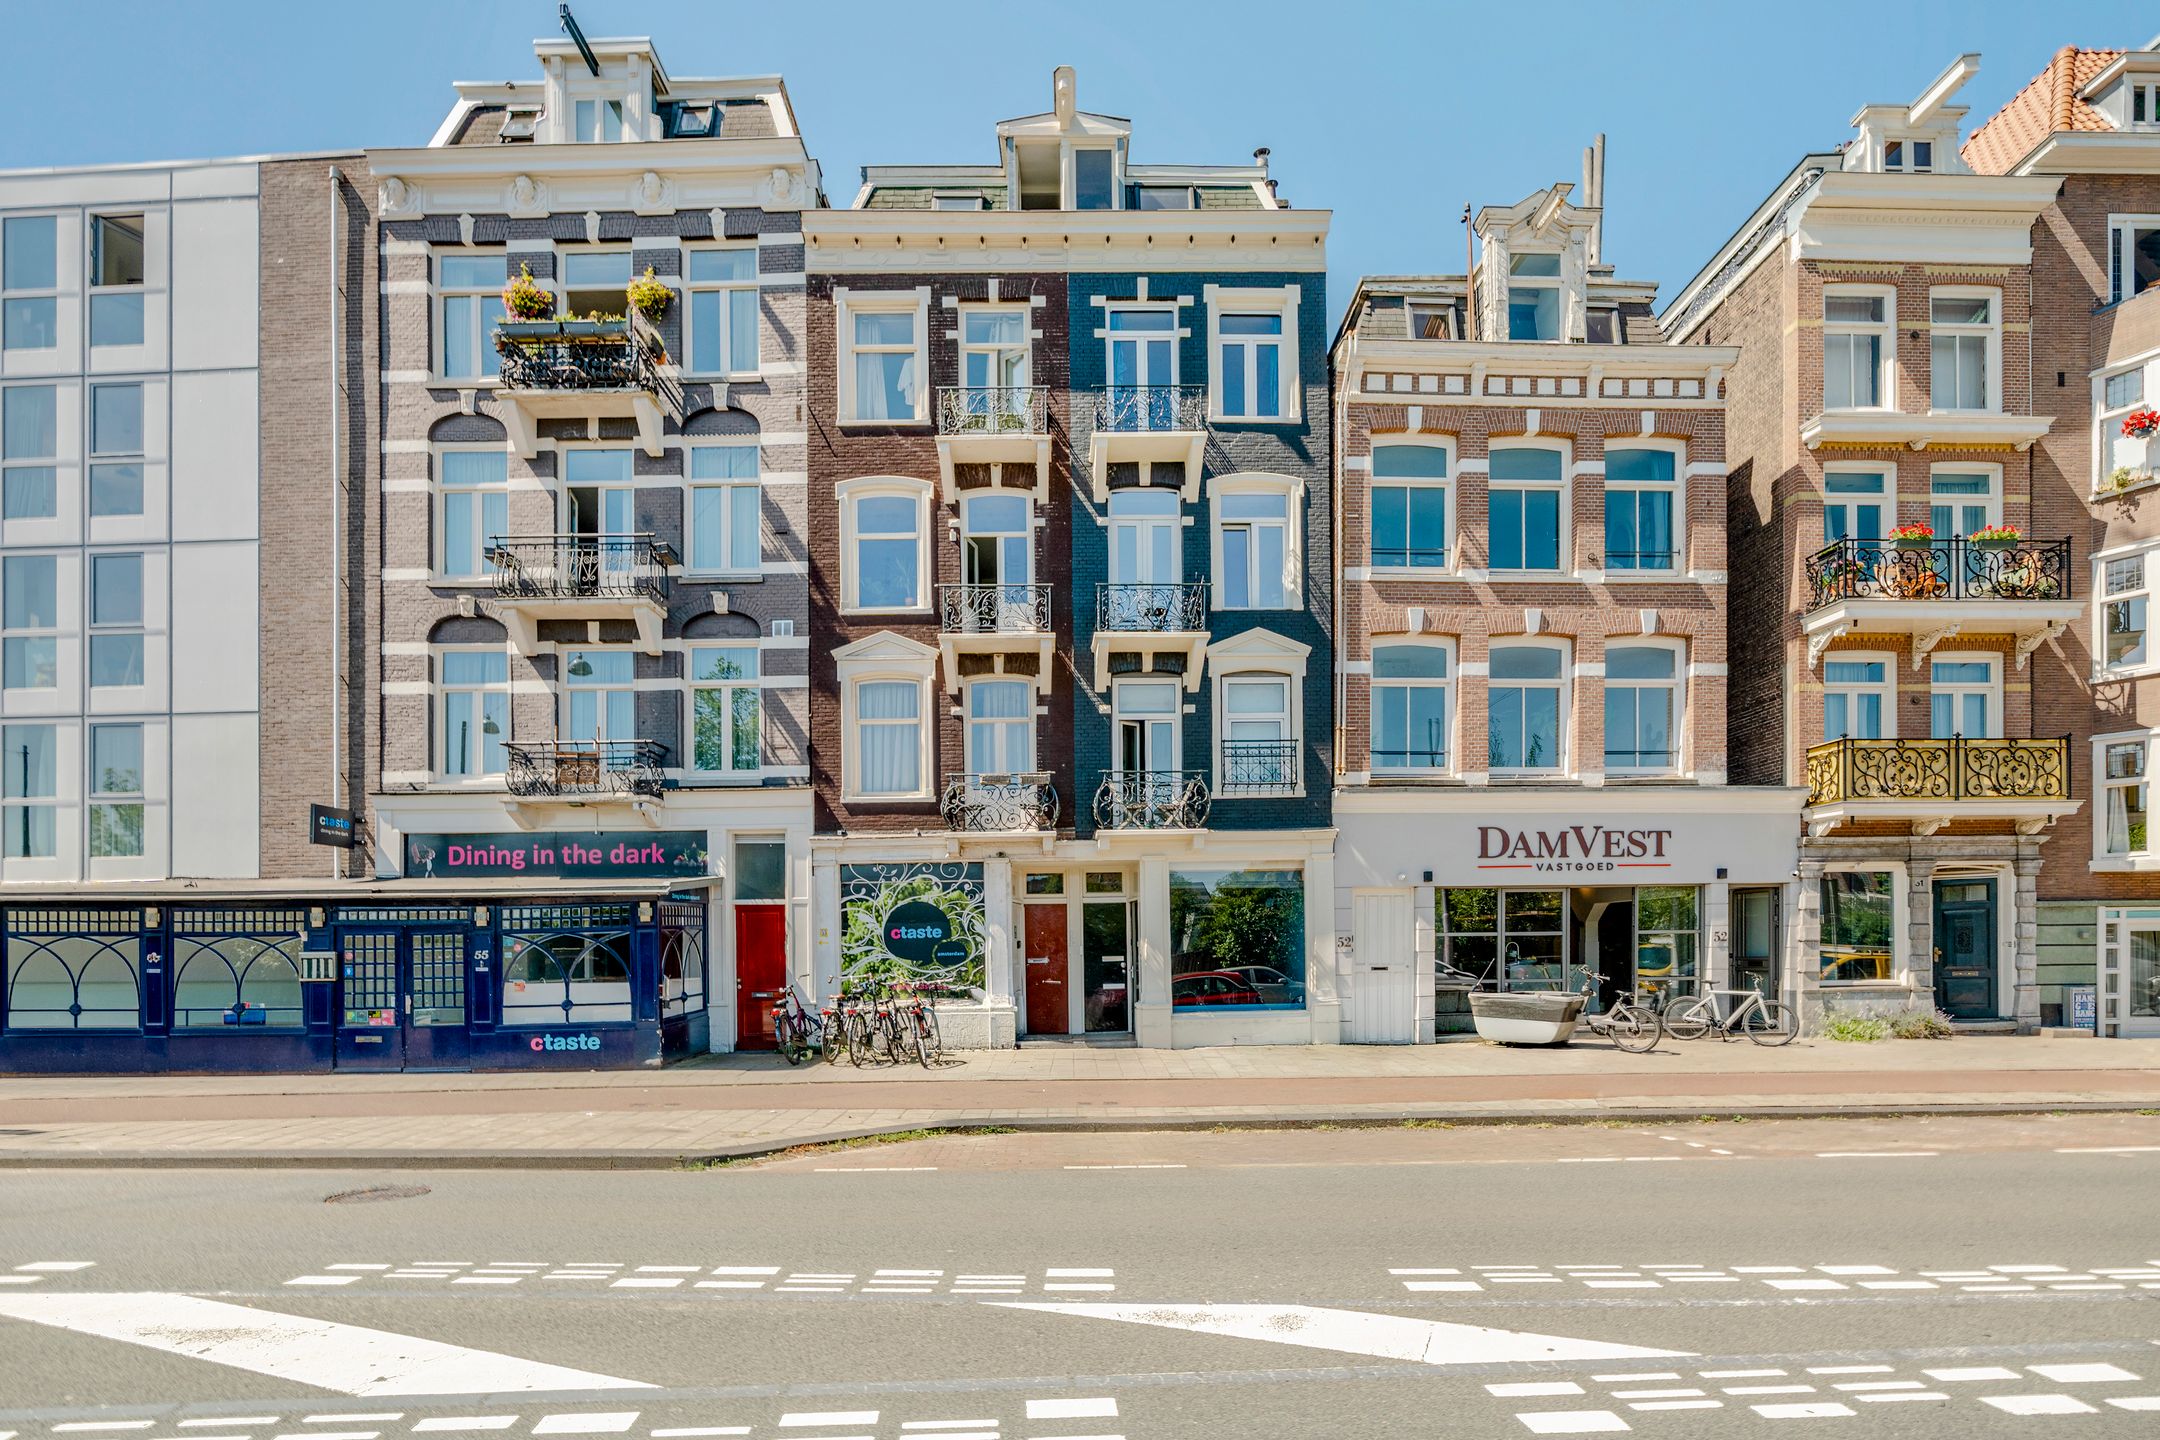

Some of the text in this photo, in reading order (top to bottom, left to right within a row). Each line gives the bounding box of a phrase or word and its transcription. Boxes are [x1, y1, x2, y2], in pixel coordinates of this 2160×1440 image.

[319, 816, 350, 829] ctaste
[448, 843, 665, 870] Dining in the dark
[1536, 862, 1614, 871] VASTGOED
[890, 925, 943, 939] ctaste
[1713, 931, 1727, 942] 52
[474, 950, 489, 960] 55
[530, 1033, 601, 1051] ctaste
